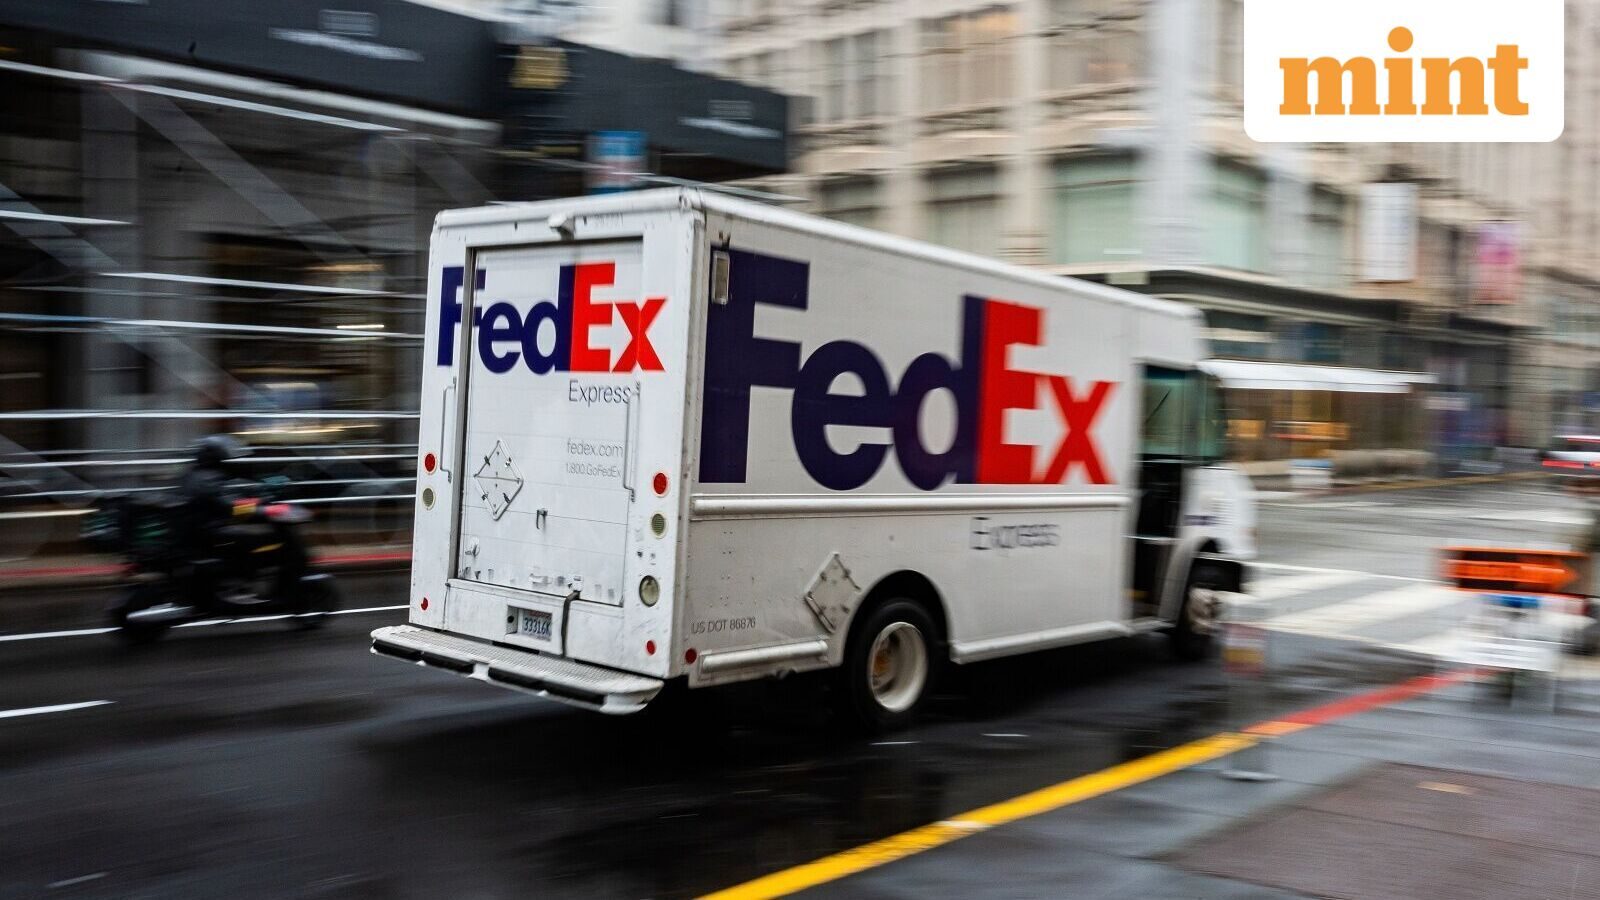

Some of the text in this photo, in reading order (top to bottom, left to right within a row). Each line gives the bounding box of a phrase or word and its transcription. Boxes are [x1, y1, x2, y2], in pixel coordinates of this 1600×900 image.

[437, 262, 667, 375] FedEx
[698, 246, 1120, 491] FedEx
[568, 379, 631, 407] Express
[567, 437, 624, 458] fedex.com
[691, 621, 705, 634] US
[708, 619, 727, 632] DOT
